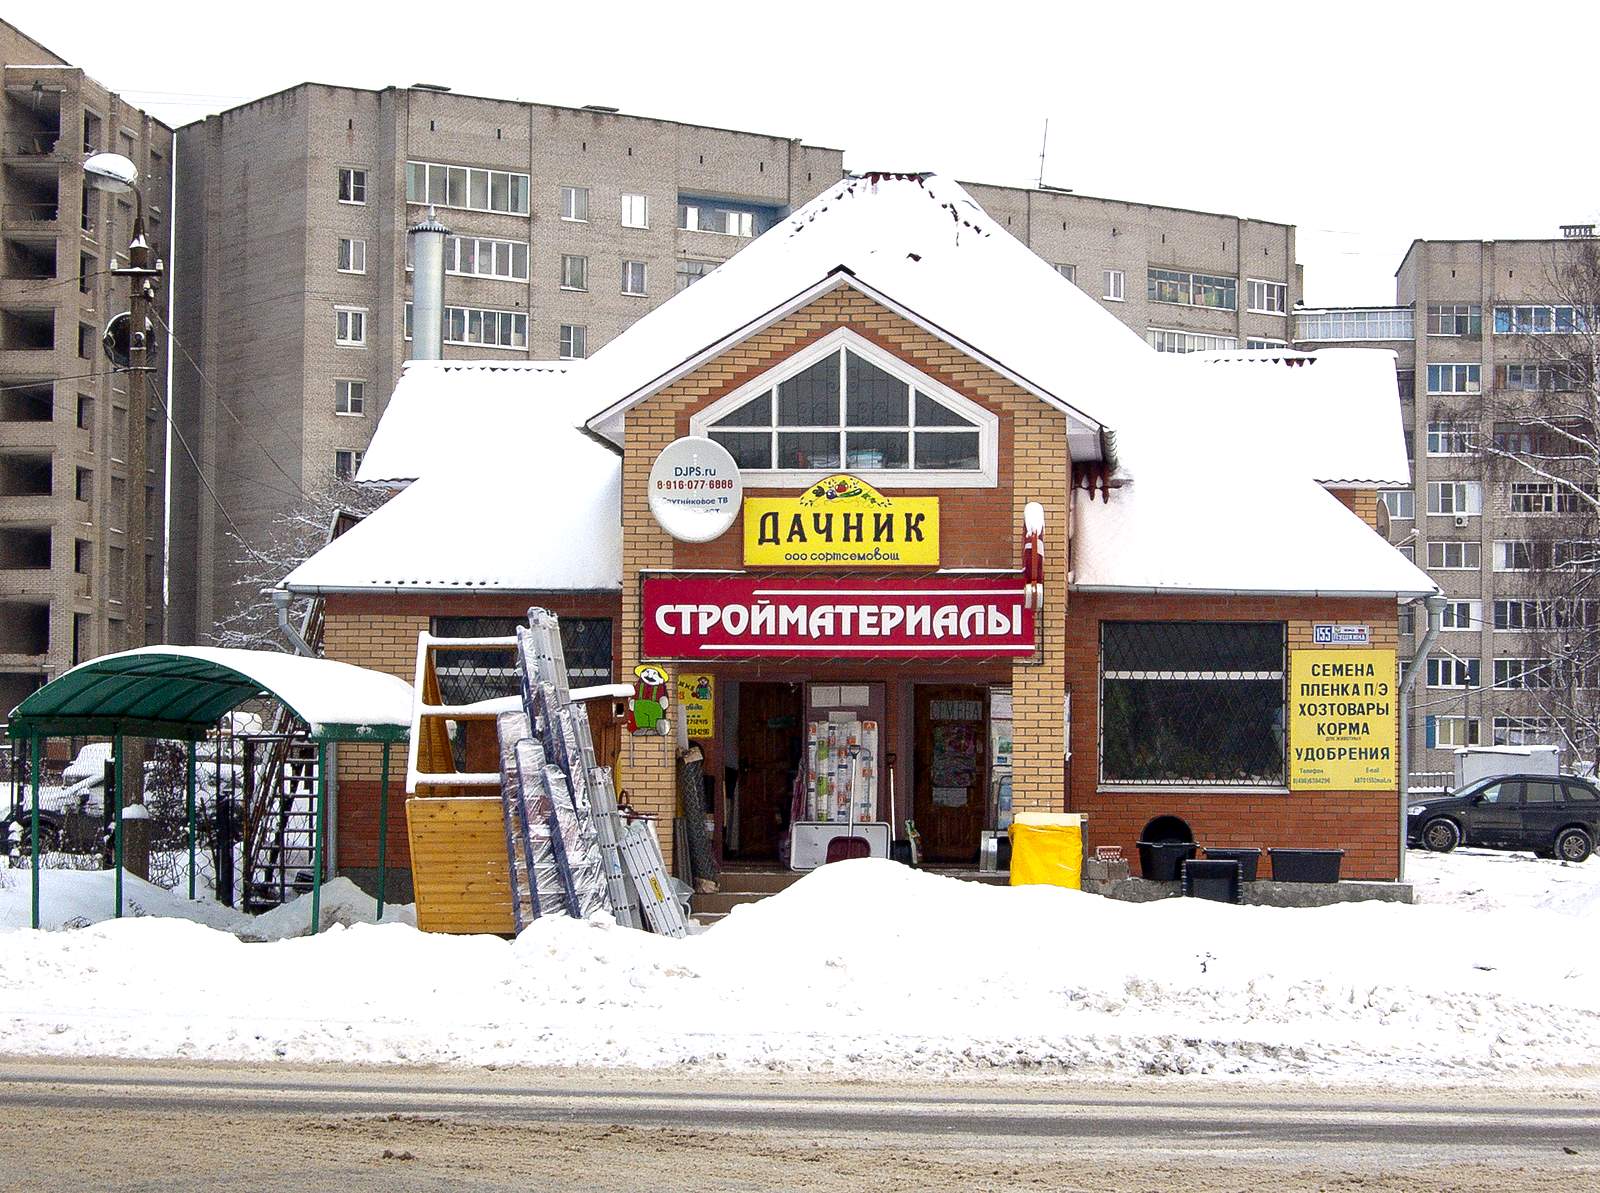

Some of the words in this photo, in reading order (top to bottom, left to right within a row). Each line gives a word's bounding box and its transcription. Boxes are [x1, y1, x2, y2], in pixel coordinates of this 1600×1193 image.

[674, 466, 716, 477] DJPS.ru
[718, 496, 729, 504] ТВ
[757, 511, 926, 545] ДАЧНИК
[655, 600, 1022, 640] СТРОЙМАТЕРИАЛЫ
[1316, 627, 1331, 642] 155
[1311, 663, 1375, 677] СЕМЕНА
[1300, 683, 1361, 697] ПЛЕНКА
[1298, 703, 1389, 717] ХОЗТОВАРЫ
[1317, 722, 1370, 736] КОРМА
[1295, 747, 1390, 762] УДОБРЕНИЯ
